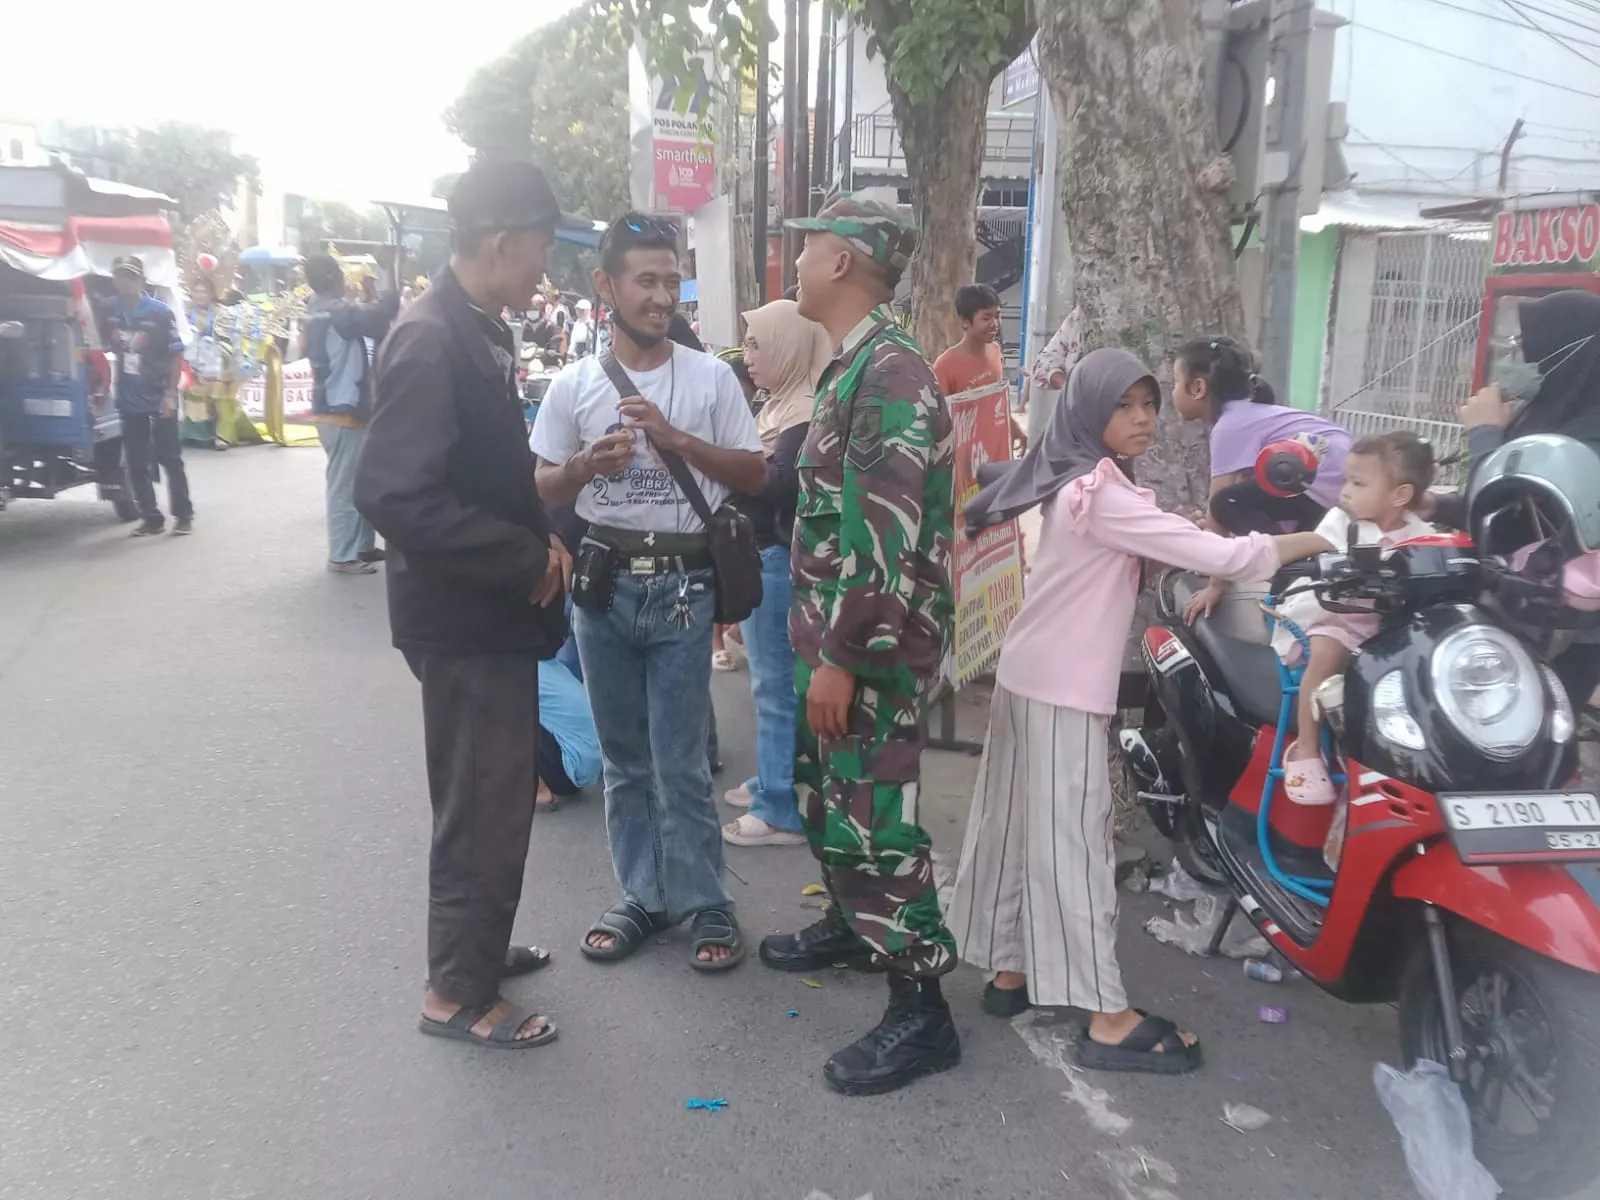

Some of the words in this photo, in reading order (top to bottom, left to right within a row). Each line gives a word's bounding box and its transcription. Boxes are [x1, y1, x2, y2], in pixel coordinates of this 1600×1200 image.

[654, 117, 671, 128] POS
[1493, 204, 1600, 265] BAKSO
[593, 478, 609, 506] 2
[988, 573, 1016, 611] TANPA
[1453, 804, 1471, 826] S
[1485, 802, 1545, 825] 2190
[1563, 800, 1596, 823] TY
